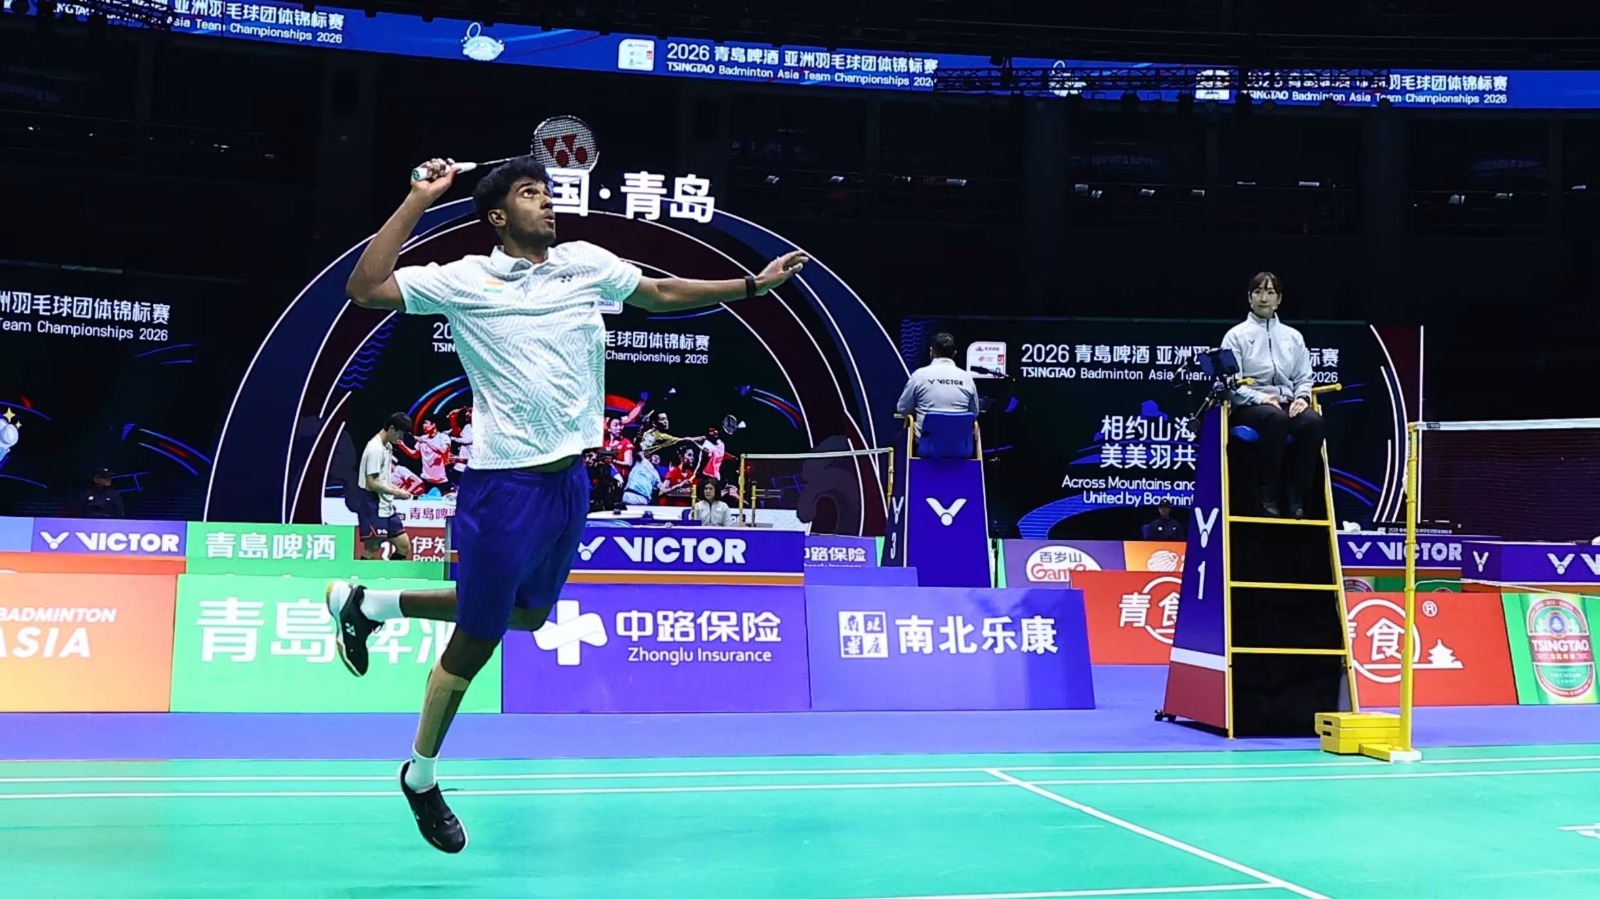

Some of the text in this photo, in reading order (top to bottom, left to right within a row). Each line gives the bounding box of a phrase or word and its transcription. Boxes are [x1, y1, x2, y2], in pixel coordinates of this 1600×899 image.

[230, 23, 312, 41] Championships
[317, 32, 343, 43] 2026
[667, 42, 710, 61] 2026
[784, 50, 938, 73] 亚洲羽毛球团体锦标赛
[666, 61, 715, 74] TSINGTAO
[718, 65, 773, 79] Badminton
[777, 69, 799, 80] Asia
[804, 71, 830, 81] Team
[834, 72, 909, 87] Championships
[1349, 92, 1371, 102] Asia
[1405, 93, 1479, 105] Championships
[1483, 94, 1507, 104] 2026
[37, 320, 133, 341] Championships
[139, 328, 169, 342] 2026
[433, 322, 453, 339] 20
[432, 342, 456, 352] TSIN
[1021, 344, 1069, 363] 2026
[605, 350, 709, 364] Championships 2026
[1021, 366, 1076, 378] TSINGTAO
[1080, 368, 1143, 380] Badminton
[1149, 369, 1174, 381] Asia
[1312, 371, 1339, 383] 2026
[1101, 415, 1196, 441] 相约山海
[1100, 443, 1196, 470] 美美羽共
[1062, 475, 1106, 489] Across
[1108, 476, 1171, 490] Mountains
[1083, 490, 1123, 504] United
[1126, 491, 1141, 507] by
[75, 532, 179, 552] VICTOR
[612, 537, 747, 564] VICTOR
[890, 532, 897, 559] 3
[1039, 551, 1082, 564] 百岁山
[1197, 561, 1206, 600] 1
[0, 607, 117, 623] BADMINTON
[615, 610, 782, 643] 中路保险
[895, 615, 1058, 655] 南北乐康
[1531, 639, 1589, 652] TSINGTAO
[628, 647, 772, 666] Zhonglu Insurance
